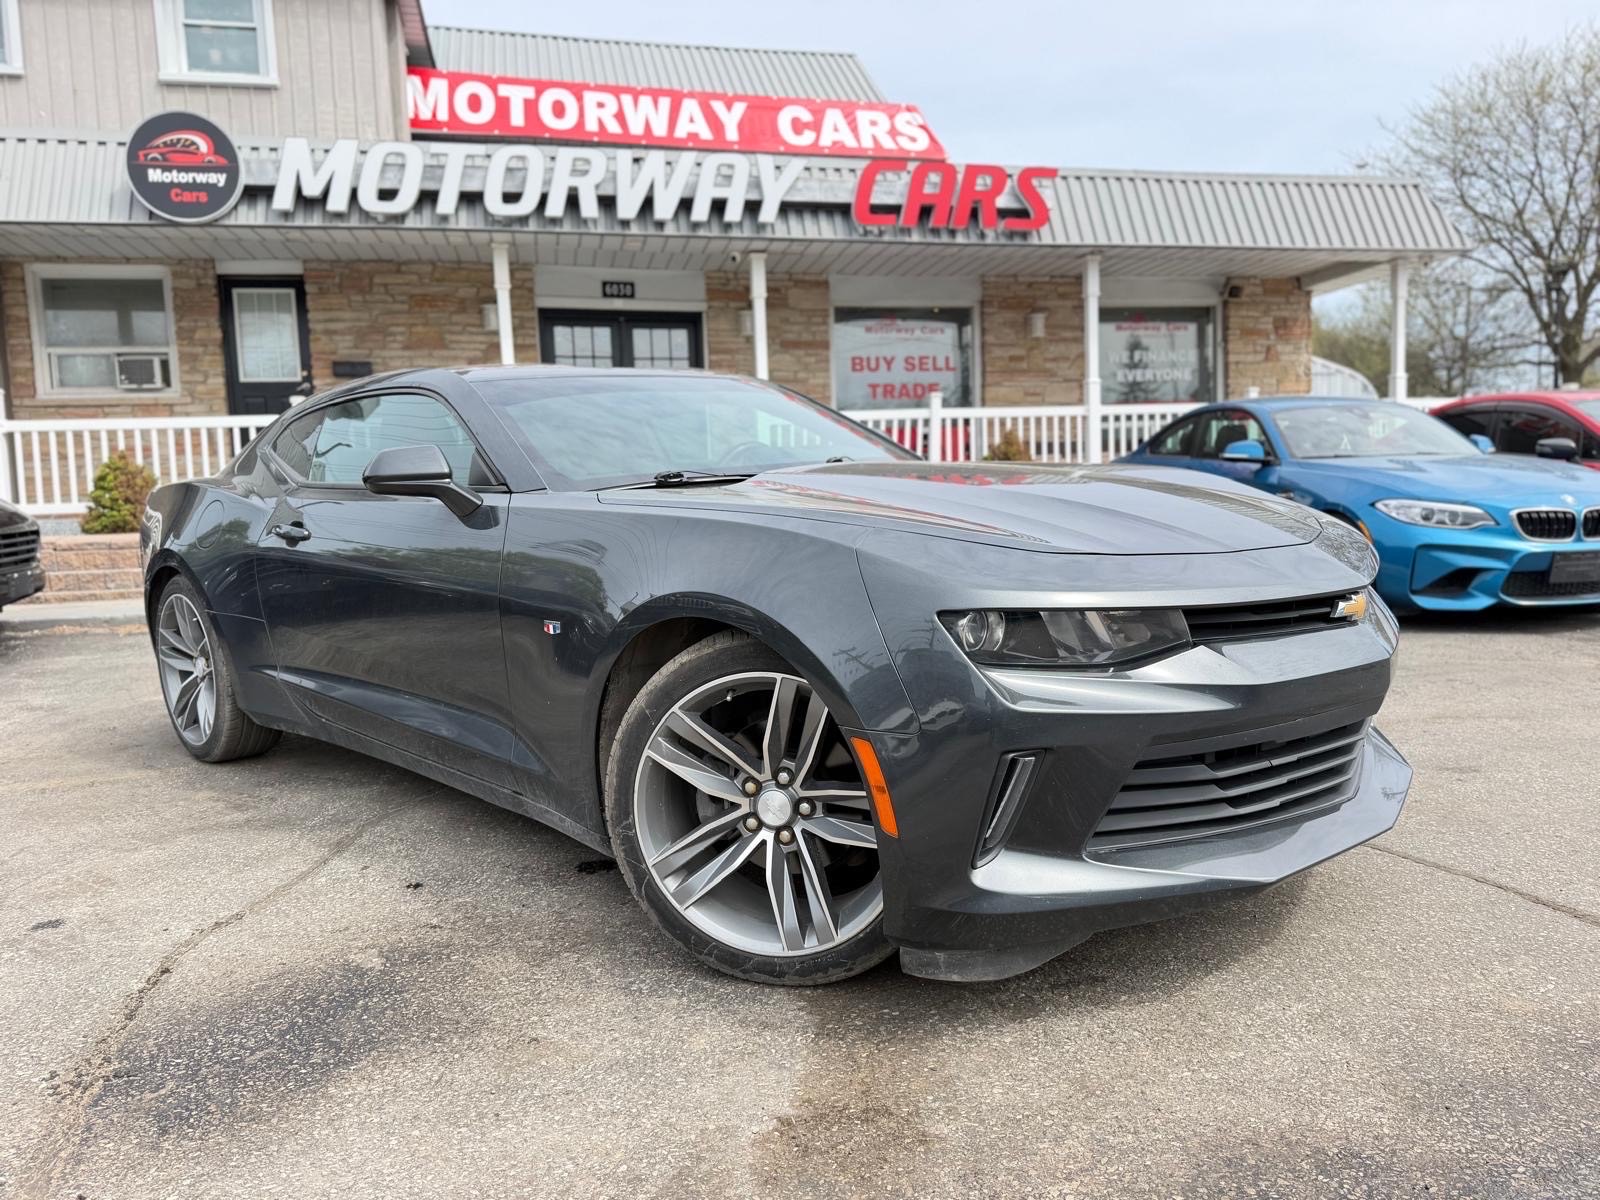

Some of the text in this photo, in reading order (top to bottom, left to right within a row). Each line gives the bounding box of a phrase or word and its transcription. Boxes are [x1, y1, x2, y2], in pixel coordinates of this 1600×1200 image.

[407, 73, 930, 151] MOTORWAY CARS
[147, 168, 227, 187] Motorway
[271, 137, 1058, 231] MOTORWAY CARS
[170, 187, 209, 203] Cars
[920, 325, 946, 335] Cars
[851, 355, 957, 373] BUY SELL
[1116, 367, 1193, 383] EVERYONE
